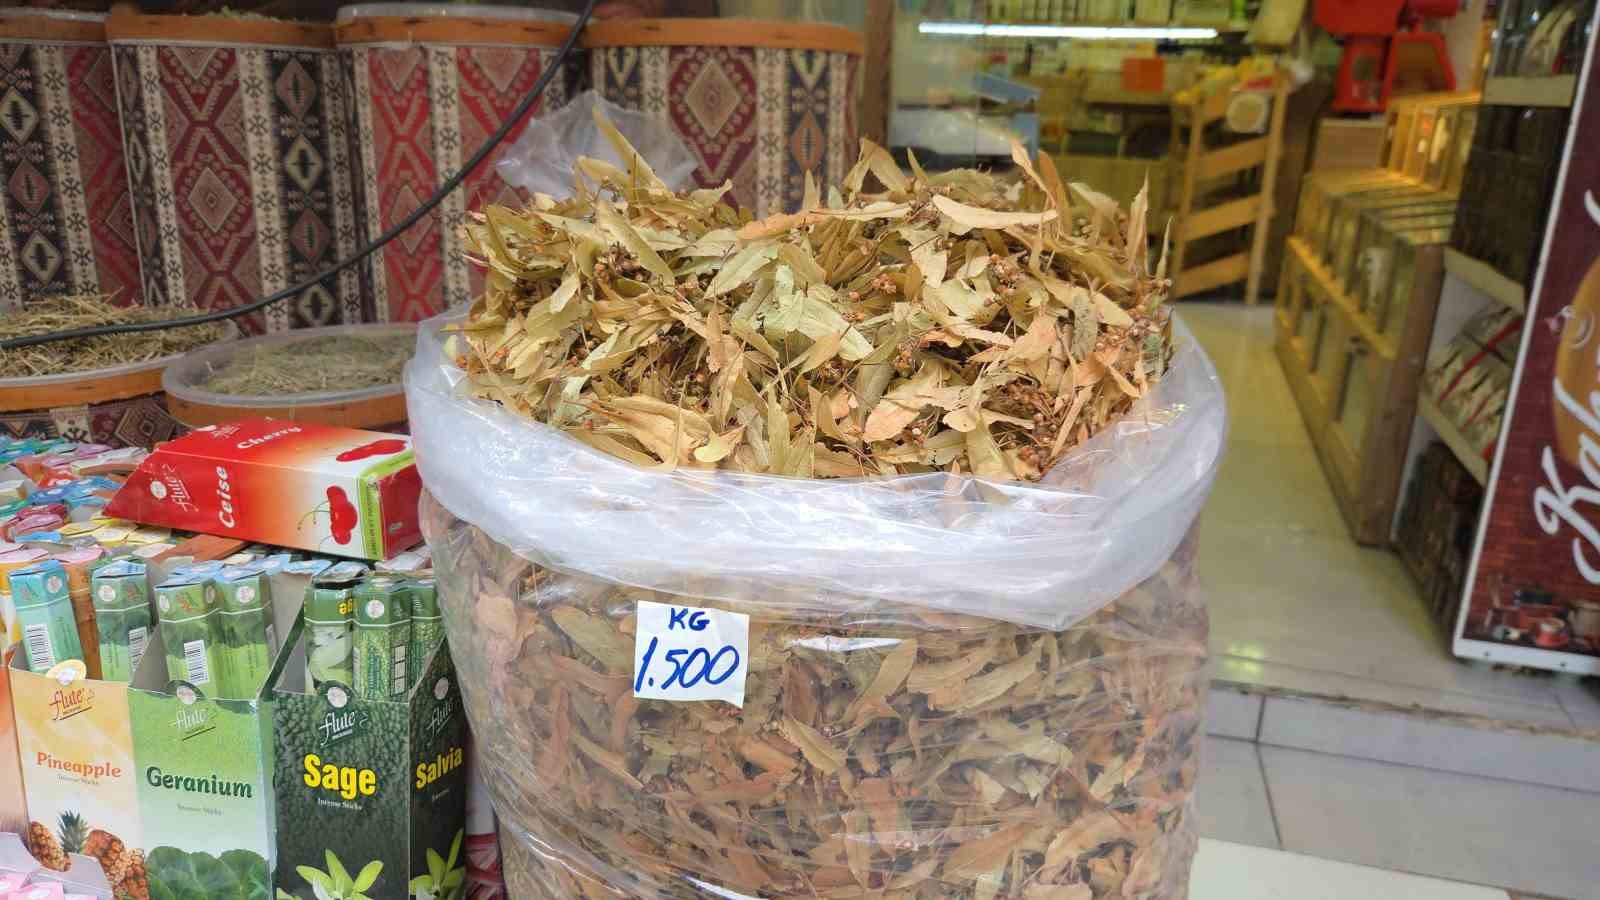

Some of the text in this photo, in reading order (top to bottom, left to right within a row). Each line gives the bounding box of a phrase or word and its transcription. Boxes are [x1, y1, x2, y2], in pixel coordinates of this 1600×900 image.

[237, 426, 302, 449] Cherry
[216, 465, 236, 528] Ceise
[668, 607, 711, 631] KG
[635, 636, 740, 692] 1.500
[318, 711, 356, 747] flute
[37, 751, 122, 779] Pineapple
[146, 766, 253, 798] Geranium
[303, 753, 377, 800] Sage
[415, 746, 464, 789] Salvia
